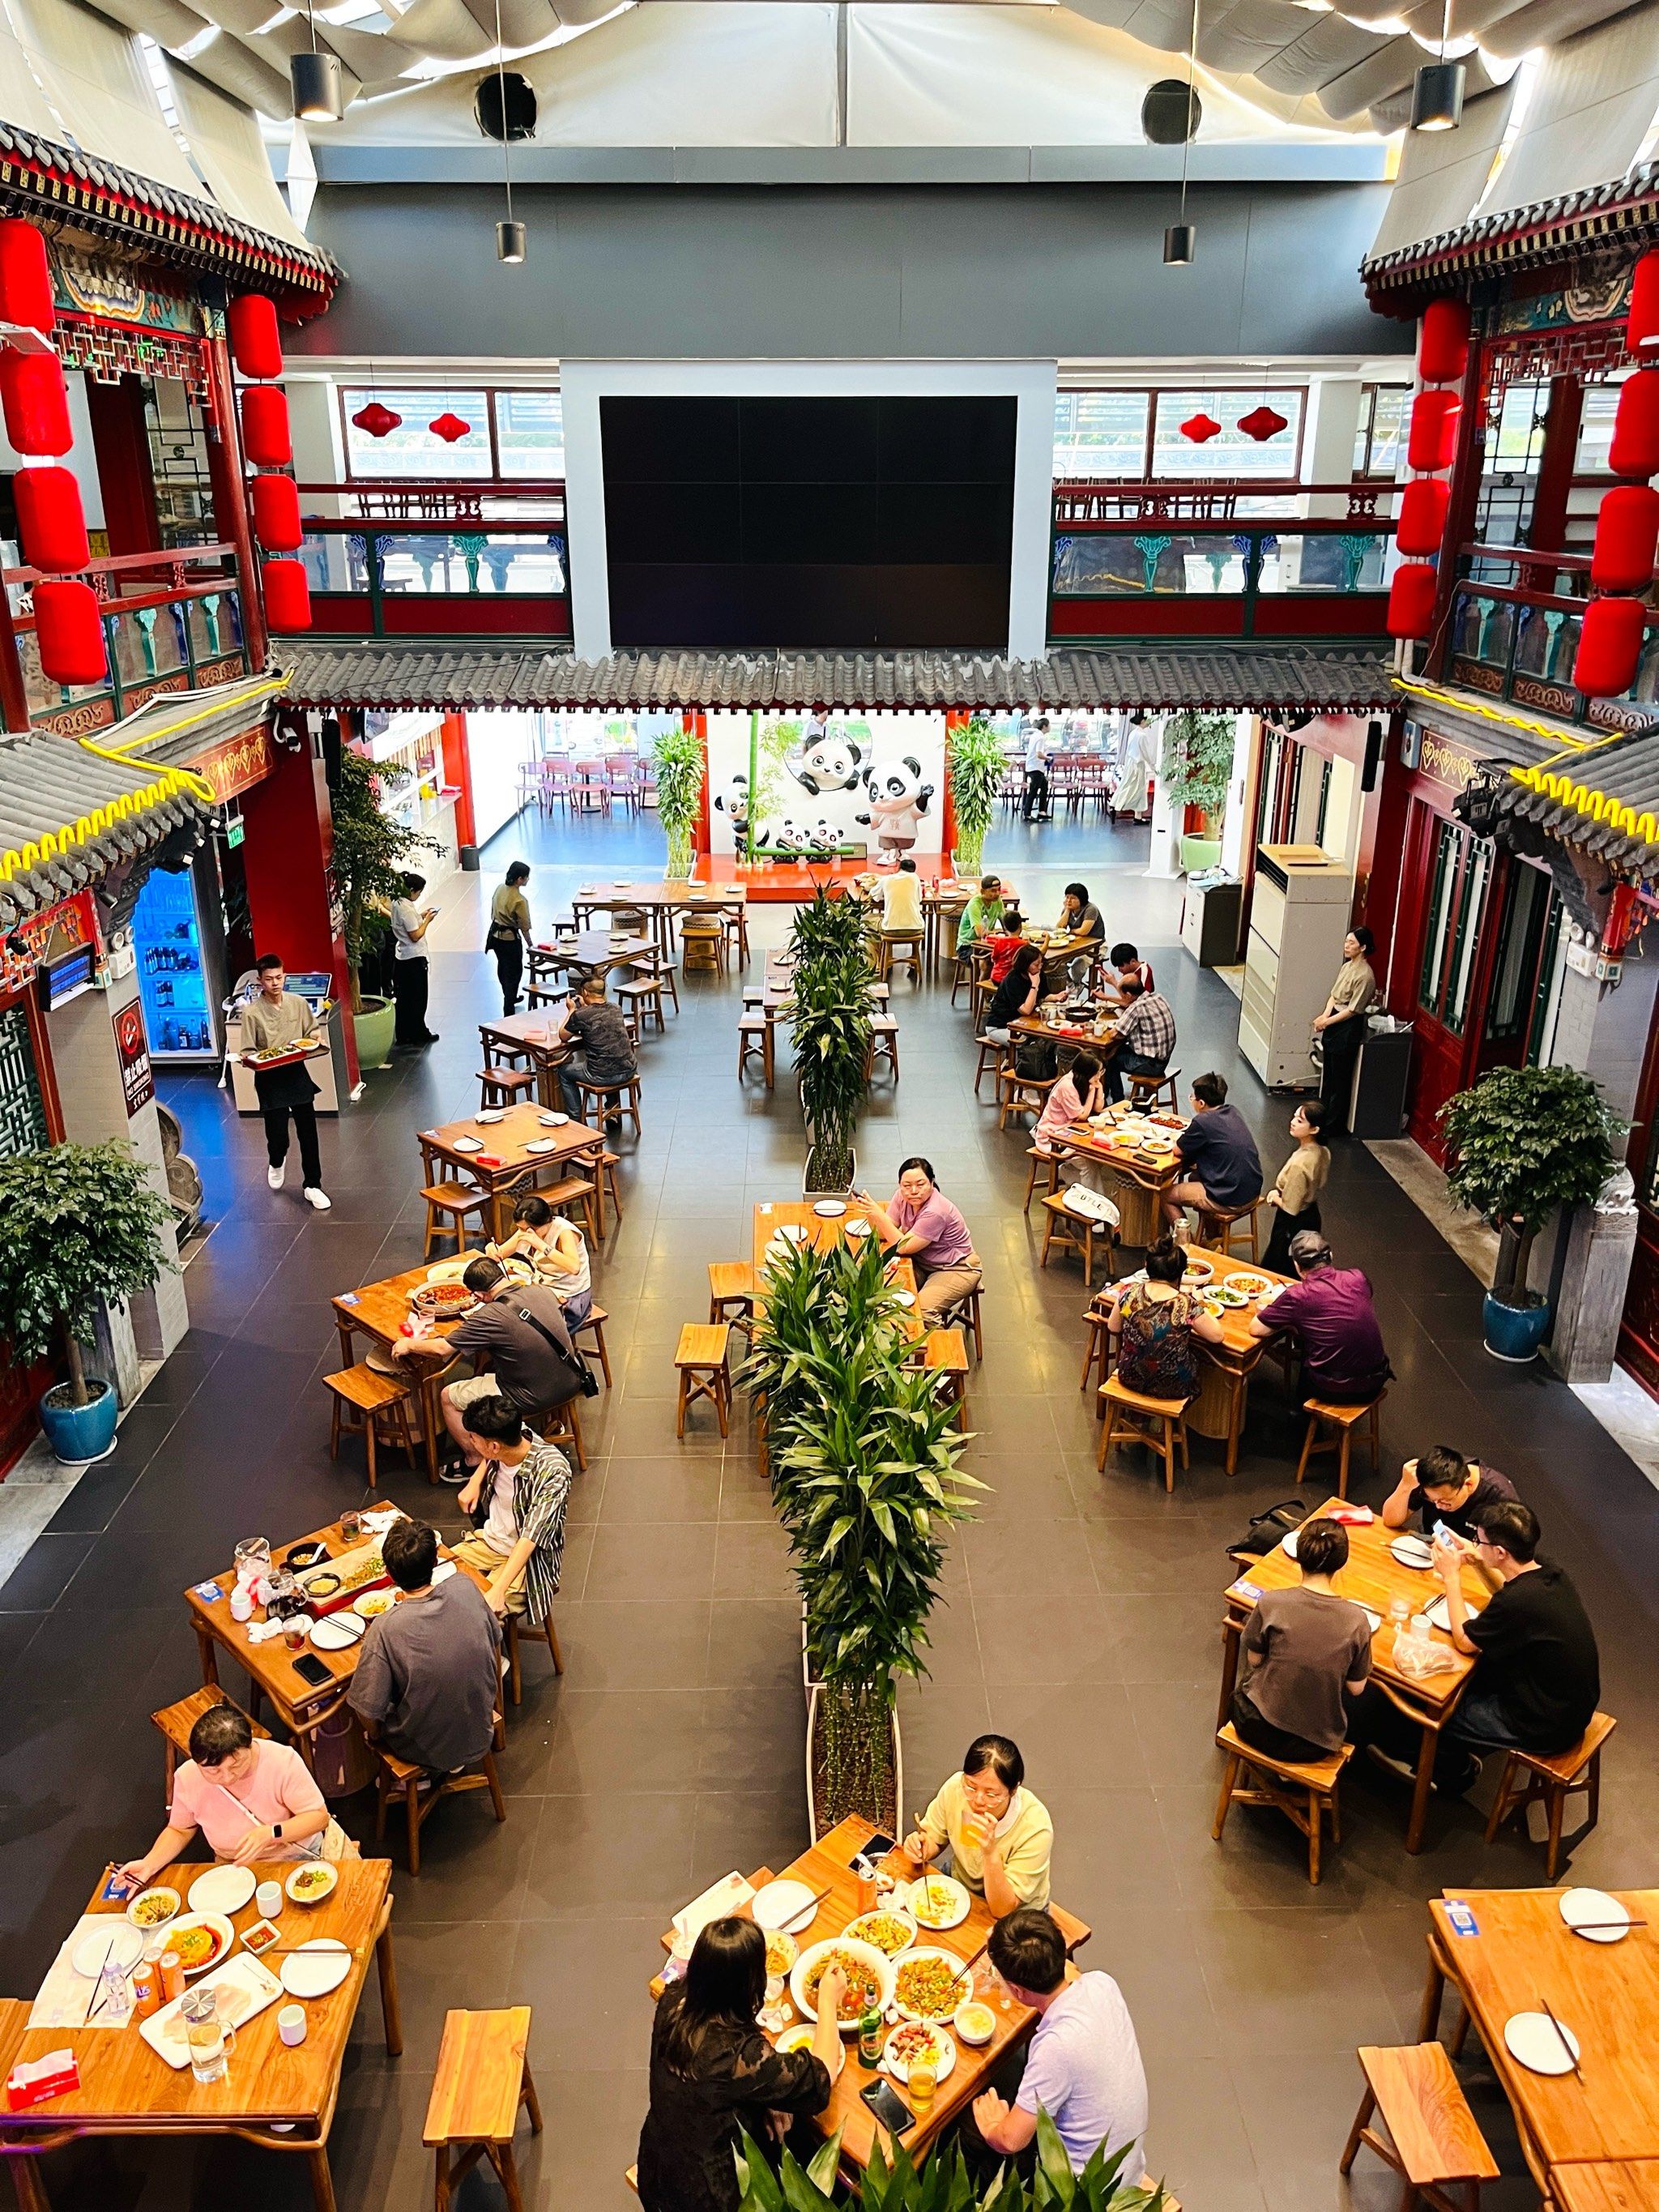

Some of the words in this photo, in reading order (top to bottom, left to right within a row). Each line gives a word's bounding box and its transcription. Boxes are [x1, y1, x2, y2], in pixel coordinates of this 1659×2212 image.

[124, 1053, 148, 1087] 禁止吸烟
[127, 1087, 134, 1096] NO
[133, 1072, 149, 1091] SMOKING
